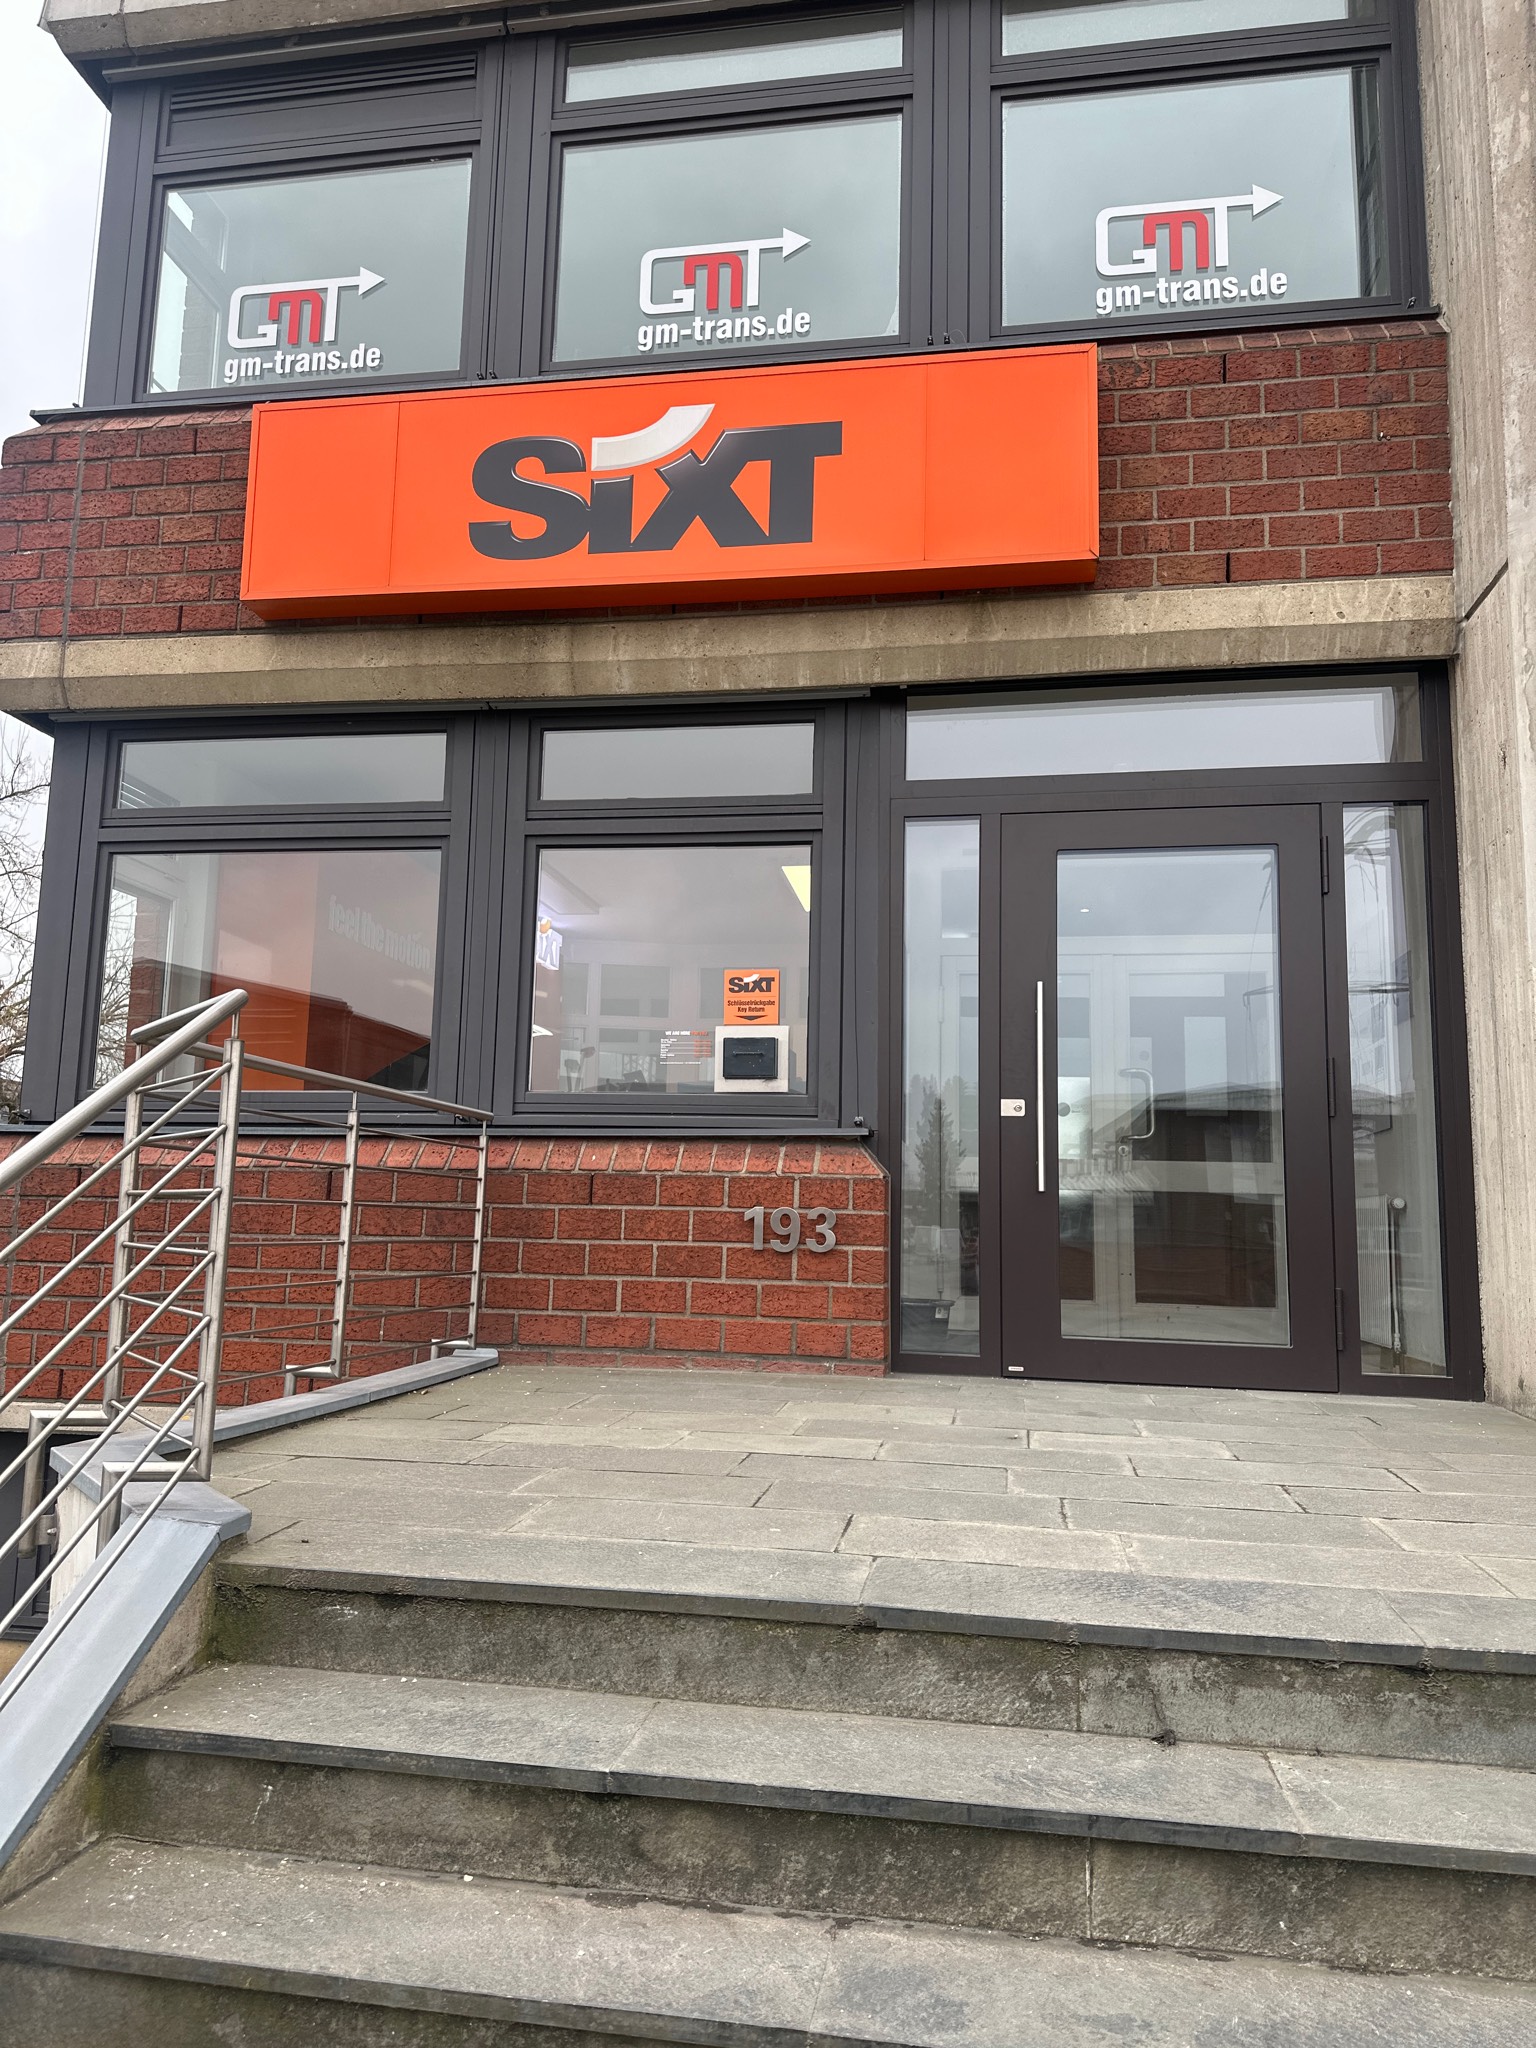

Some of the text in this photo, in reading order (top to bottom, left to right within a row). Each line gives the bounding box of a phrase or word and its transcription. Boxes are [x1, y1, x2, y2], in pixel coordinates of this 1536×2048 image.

[1096, 268, 1288, 314] gm-trans.de
[637, 308, 811, 351] gm-trans.de
[224, 343, 381, 384] gm-trans.de
[743, 1206, 836, 1253] 193
